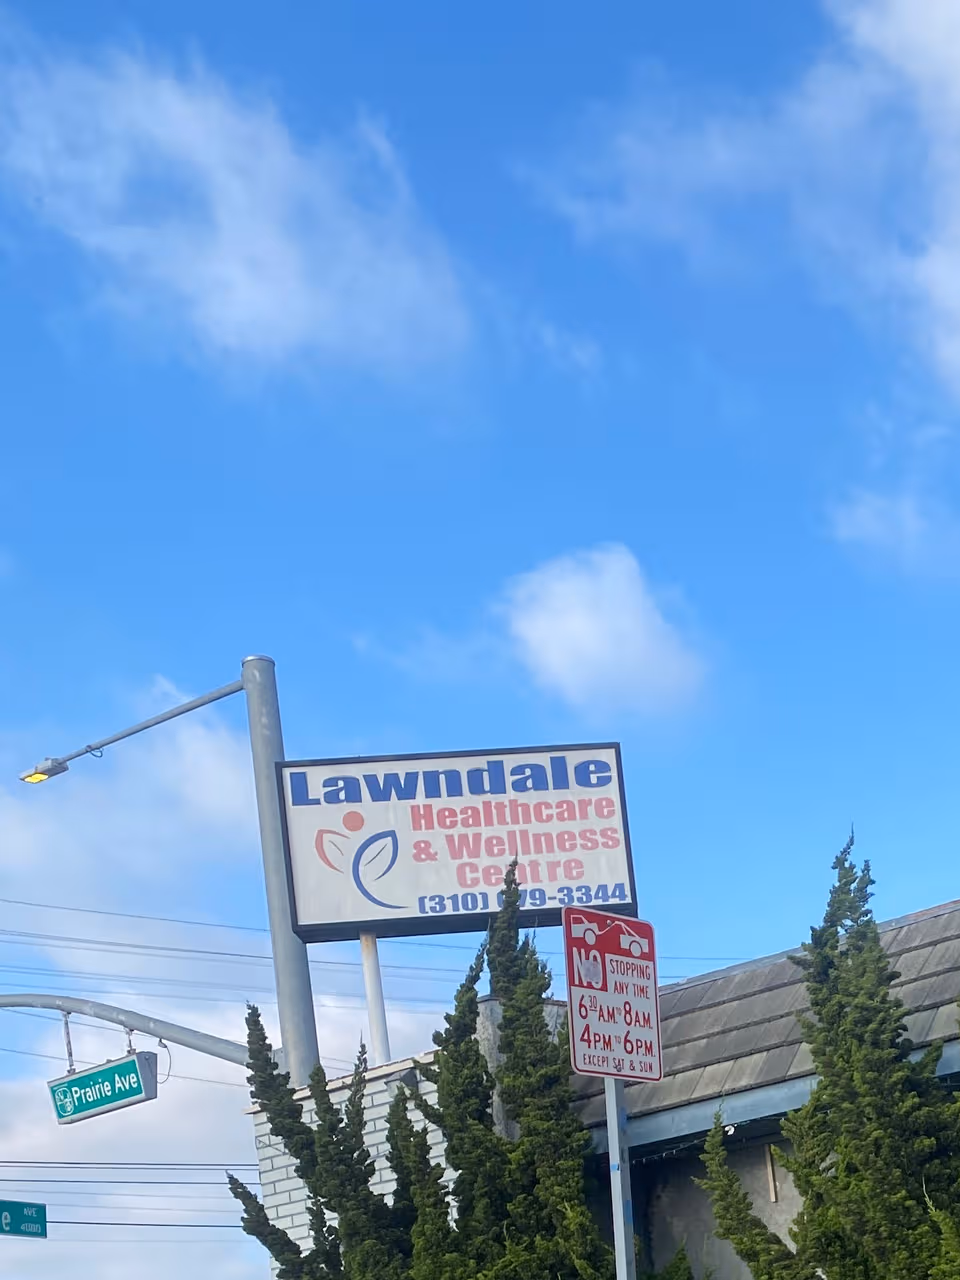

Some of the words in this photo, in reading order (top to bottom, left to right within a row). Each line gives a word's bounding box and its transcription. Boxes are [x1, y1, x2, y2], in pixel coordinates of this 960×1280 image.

[290, 756, 612, 806] Lawndale
[411, 797, 615, 831] Healthcare
[412, 840, 438, 862] &
[445, 827, 620, 860] Wellness
[456, 858, 584, 888] Centre
[573, 947, 603, 988] NO
[609, 959, 651, 980] STOPPING
[614, 980, 629, 996] ANY
[632, 983, 650, 999] TIME
[583, 1053, 609, 1068] EXCEPT
[613, 1057, 625, 1072] SAT
[629, 1060, 636, 1071] &
[639, 1061, 653, 1072] SUN
[71, 1079, 112, 1106] Prairie
[114, 1073, 138, 1095] Ave
